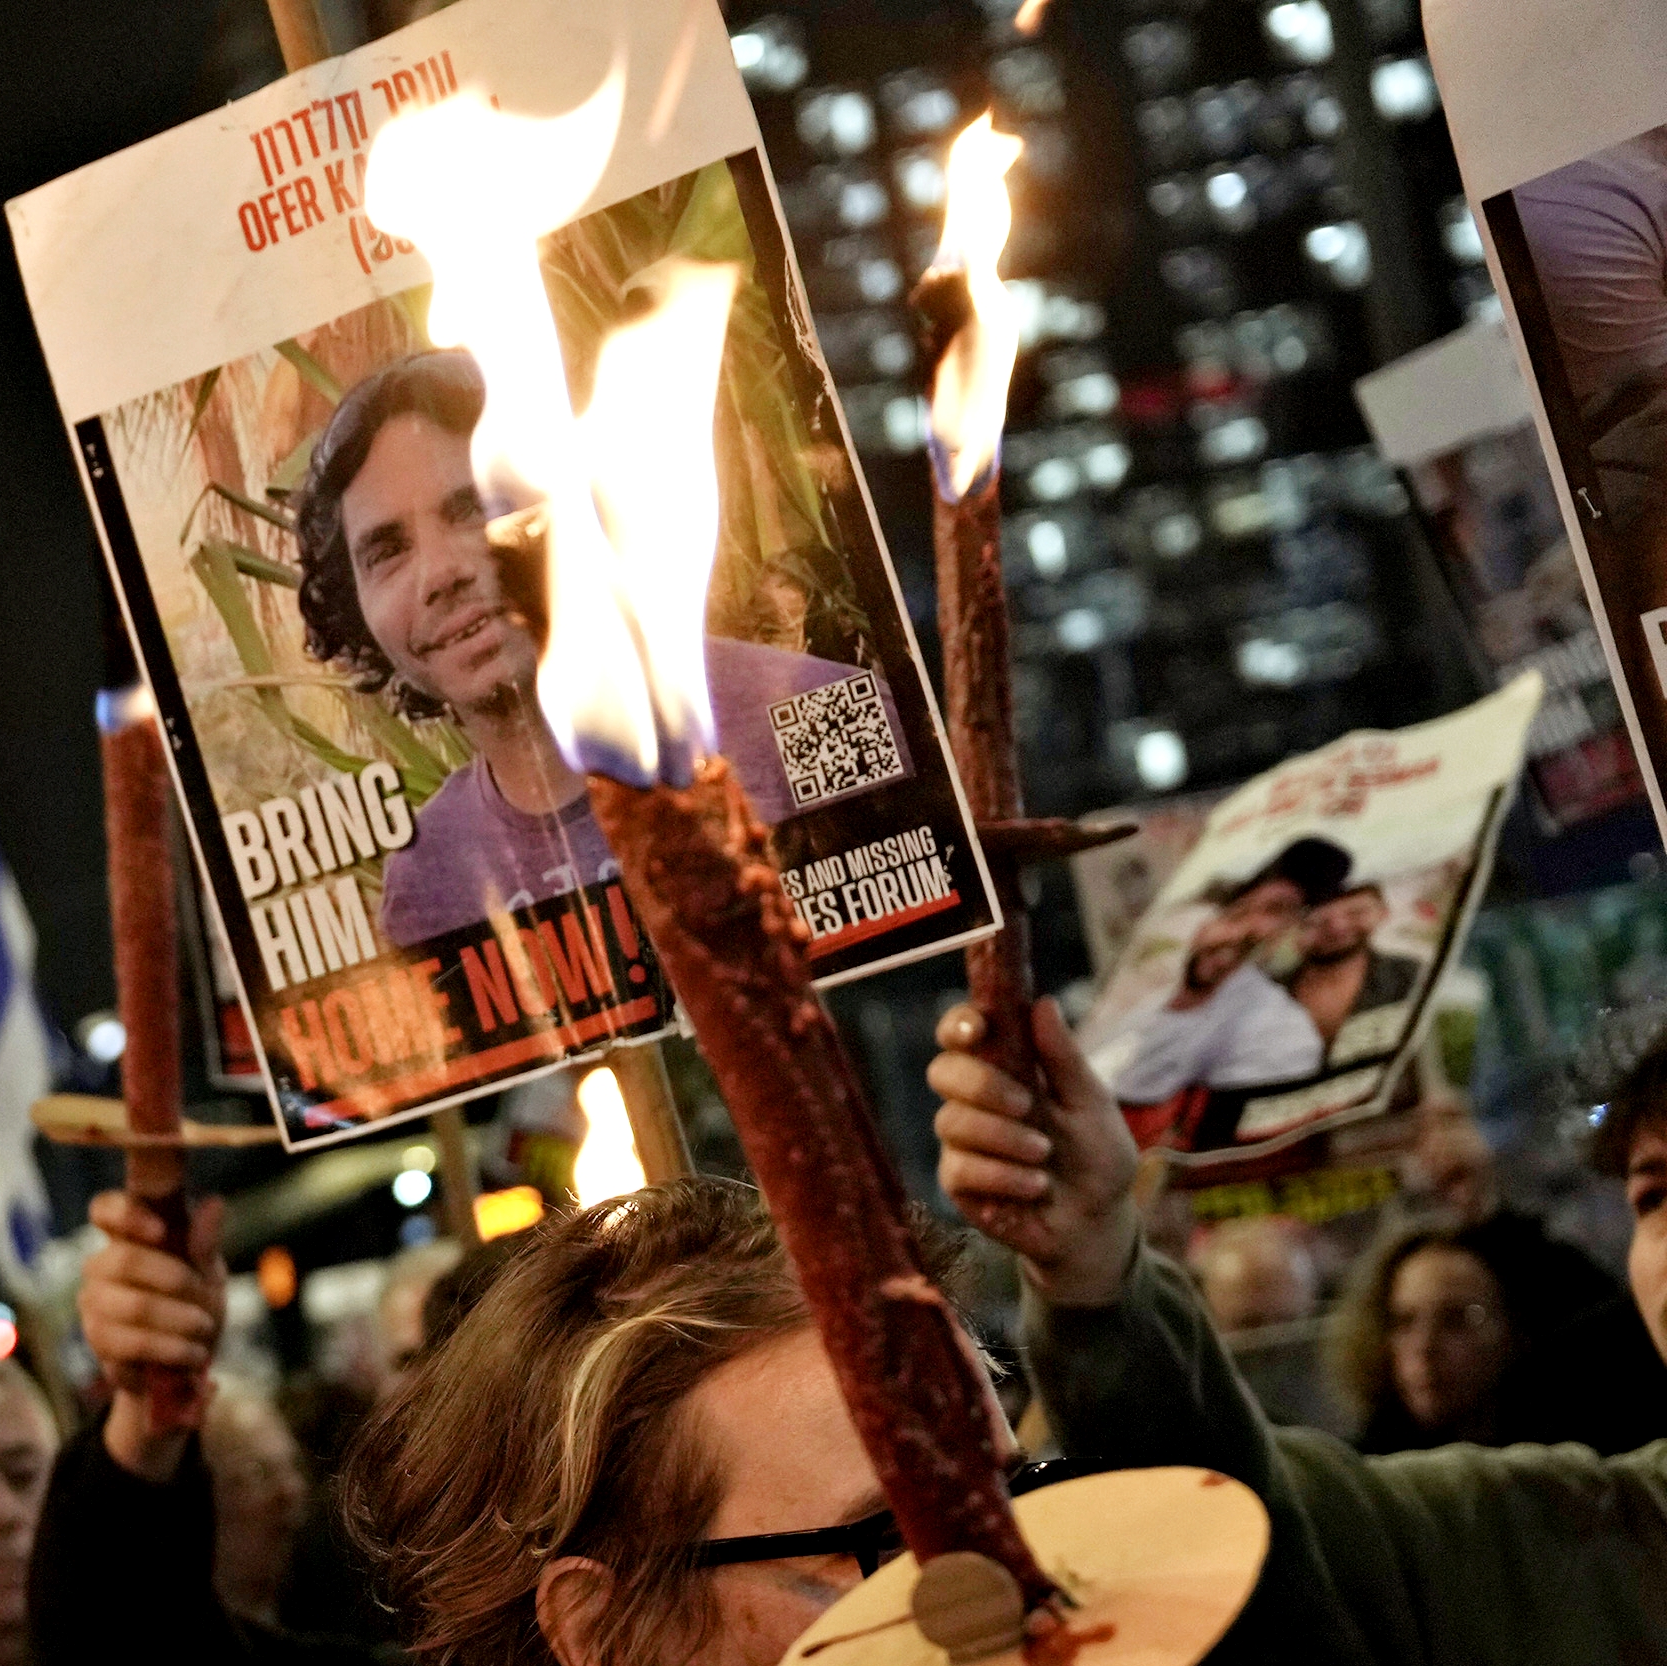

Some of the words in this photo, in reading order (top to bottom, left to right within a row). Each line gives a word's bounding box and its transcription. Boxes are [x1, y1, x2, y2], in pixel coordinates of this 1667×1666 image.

[237, 176, 325, 252] OFER
[222, 761, 415, 900] BRING
[805, 855, 847, 895] AND
[844, 825, 938, 881] MISSING
[249, 875, 378, 992] HIM
[841, 855, 951, 928] FORUM
[279, 957, 464, 1090] HOME
[458, 885, 647, 1033] NOW!
